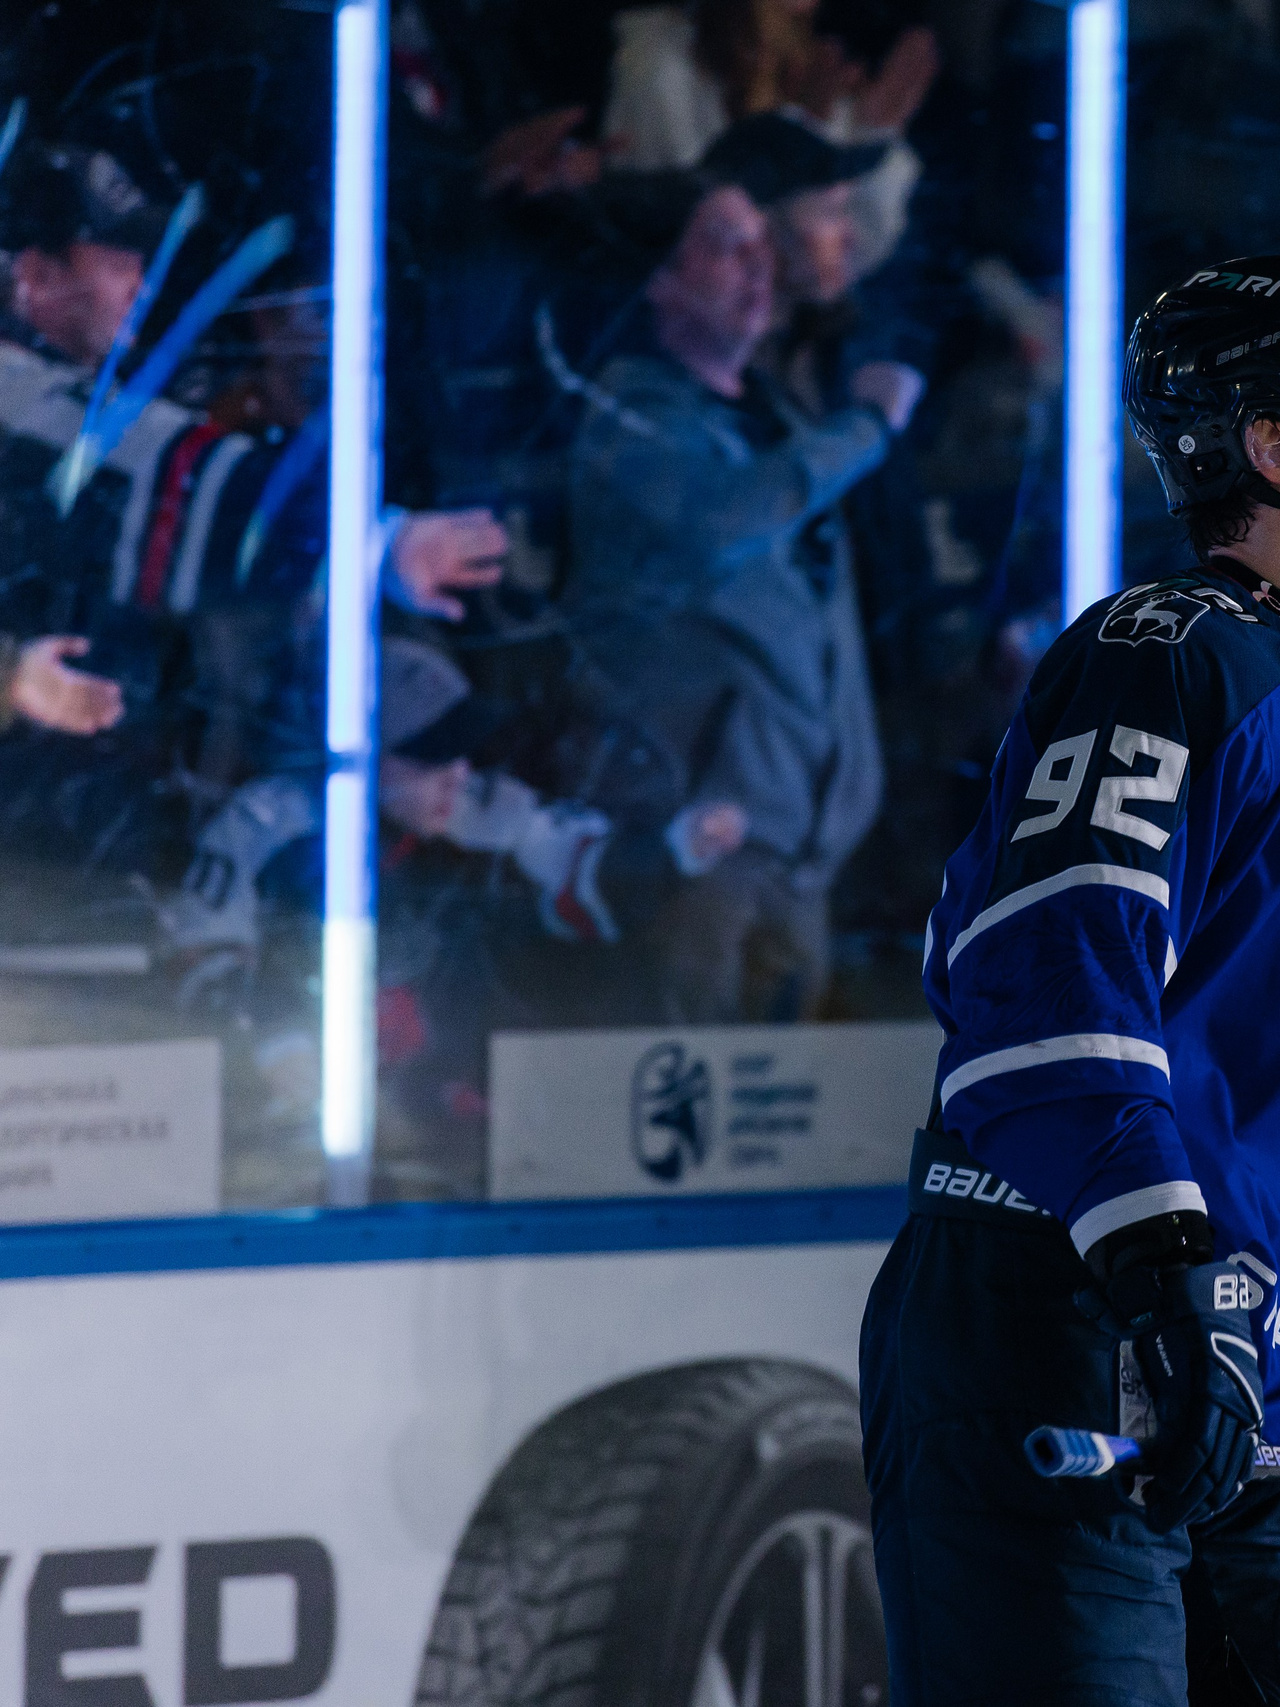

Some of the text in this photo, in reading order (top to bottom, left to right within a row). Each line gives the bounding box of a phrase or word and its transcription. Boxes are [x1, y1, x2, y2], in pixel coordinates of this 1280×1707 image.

[1010, 723, 1189, 851] 92
[923, 1163, 1051, 1216] BAUE
[0, 1535, 338, 1707] ED
